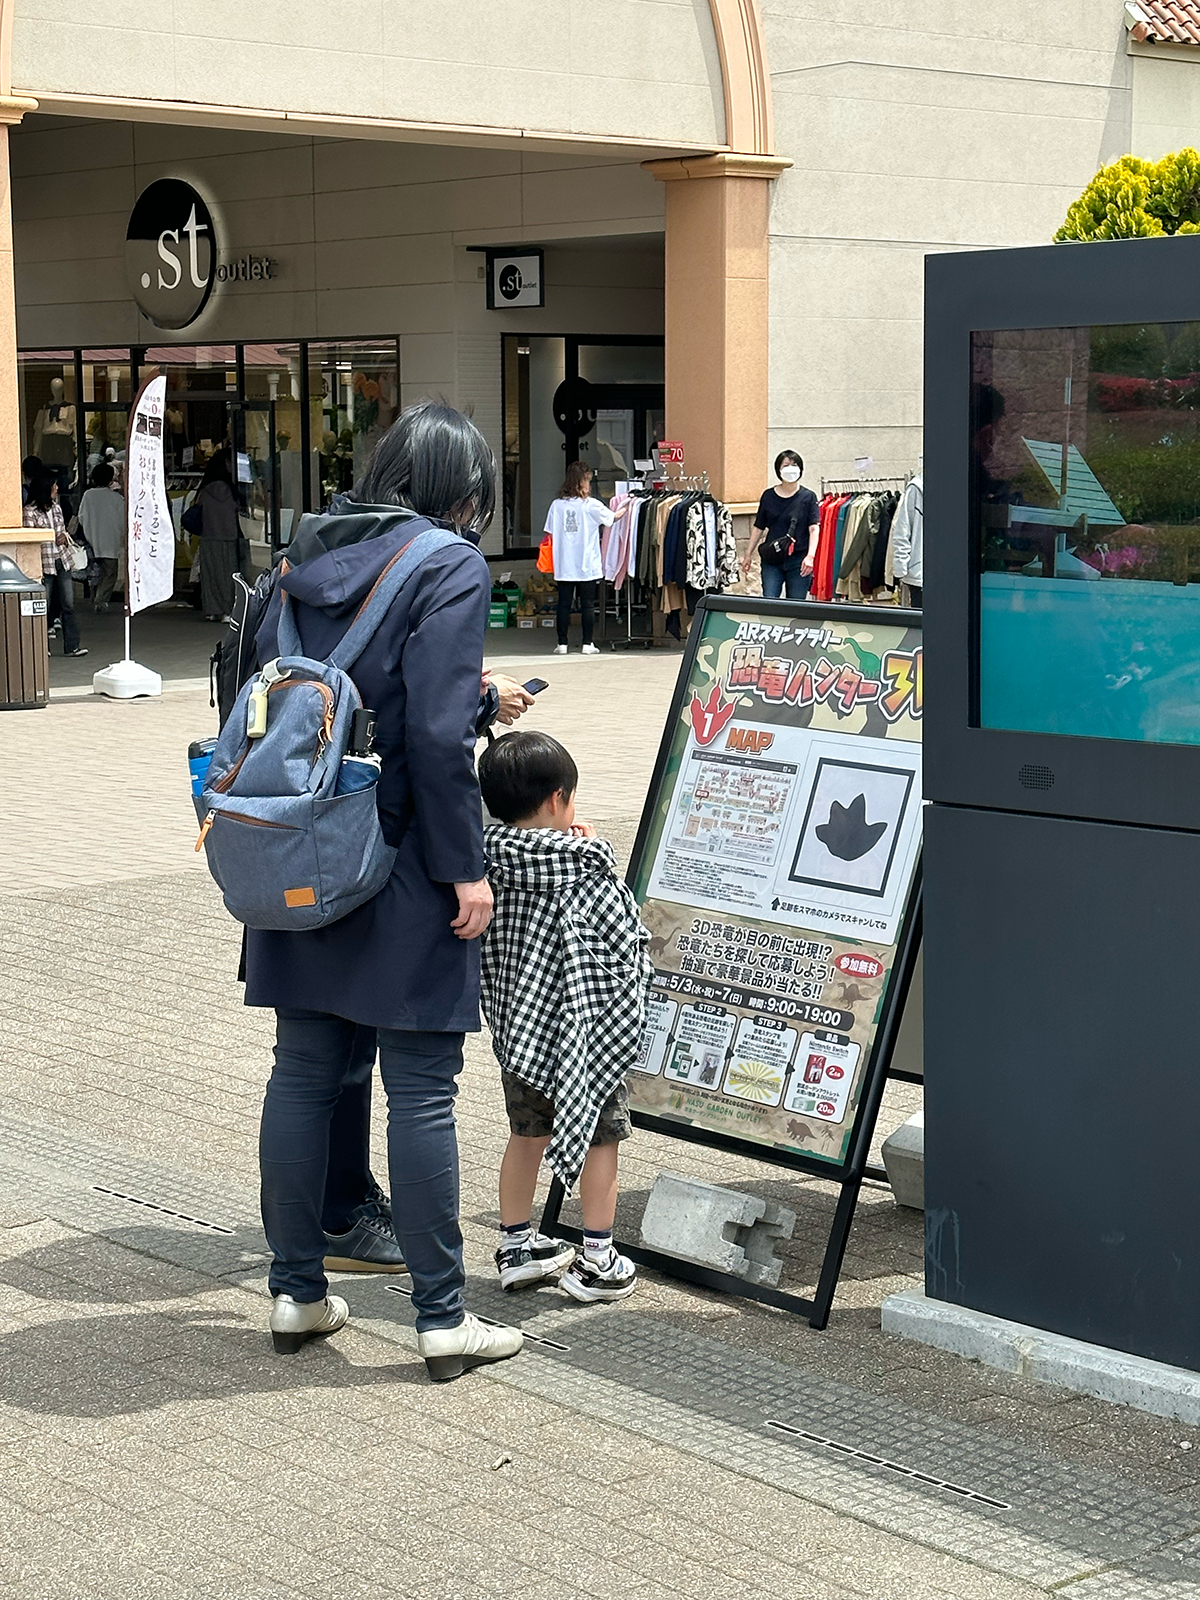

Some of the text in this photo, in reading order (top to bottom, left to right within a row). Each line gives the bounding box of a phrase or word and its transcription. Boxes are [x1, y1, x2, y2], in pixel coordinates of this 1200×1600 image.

[216, 254, 273, 282] outlet
[734, 621, 843, 649] ARスタンプラリー
[701, 711, 714, 739] 1
[725, 727, 775, 754] MAP
[780, 901, 888, 930] 足跡をスマホのカメラでスキャンしてね
[690, 919, 833, 961] 3D恐竜が目の前に出現!?
[676, 935, 836, 983] 恐竜たちを探して応募しよう!
[839, 956, 879, 977] 参加無料
[680, 955, 822, 1001] 抽選で豪華景品が当たる!!
[698, 1003, 723, 1016] STEP 2
[757, 1018, 783, 1029] STEP 3
[686, 1098, 763, 1123] NASU GARDEN OUTLET
